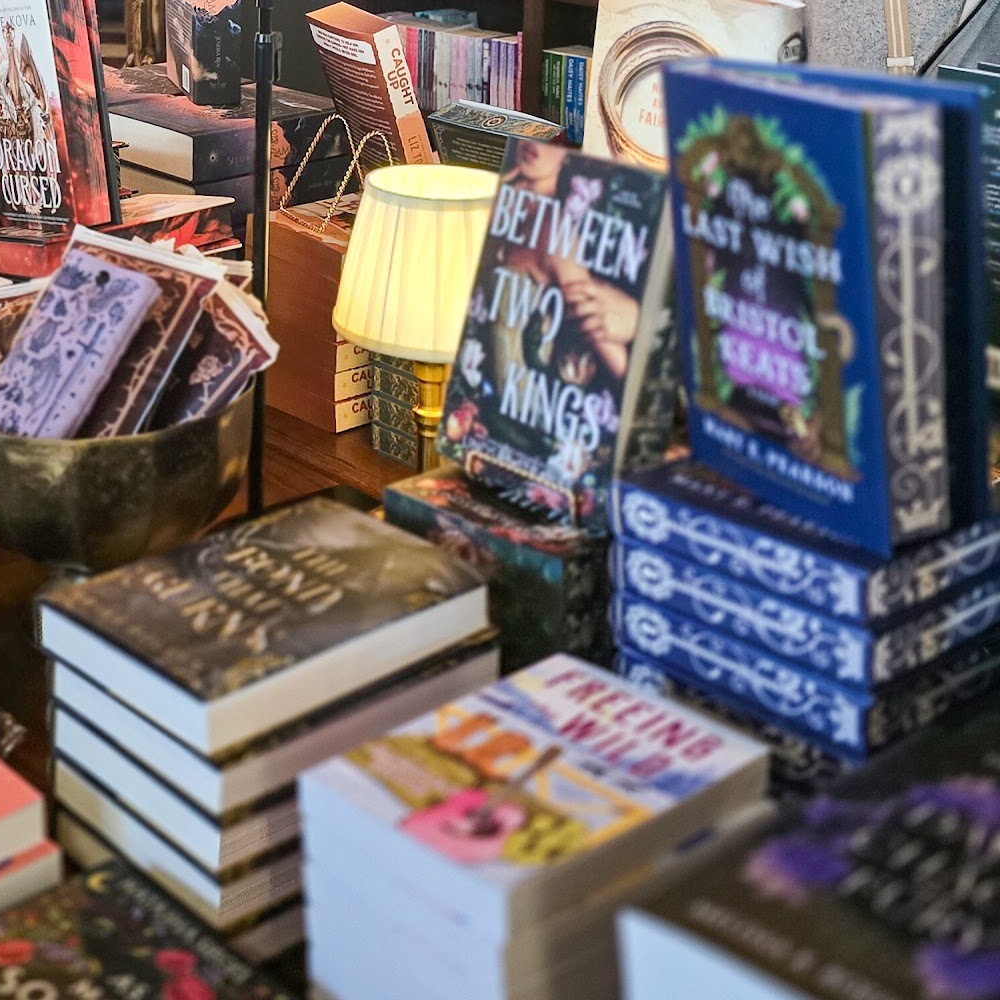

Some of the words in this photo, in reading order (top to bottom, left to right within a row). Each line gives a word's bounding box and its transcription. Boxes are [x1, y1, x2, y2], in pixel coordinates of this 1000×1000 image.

[9, 14, 36, 27] KOVA
[387, 70, 400, 90] UP
[391, 48, 414, 105] CAUGHT
[408, 135, 418, 150] LIZ
[1, 174, 62, 209] CURSED
[490, 183, 649, 285] BETWEEN
[681, 205, 743, 253] LAST
[750, 224, 843, 285] WISH
[498, 363, 601, 452] KINGS
[543, 667, 728, 765] FREEING
[554, 711, 676, 779] WILD
